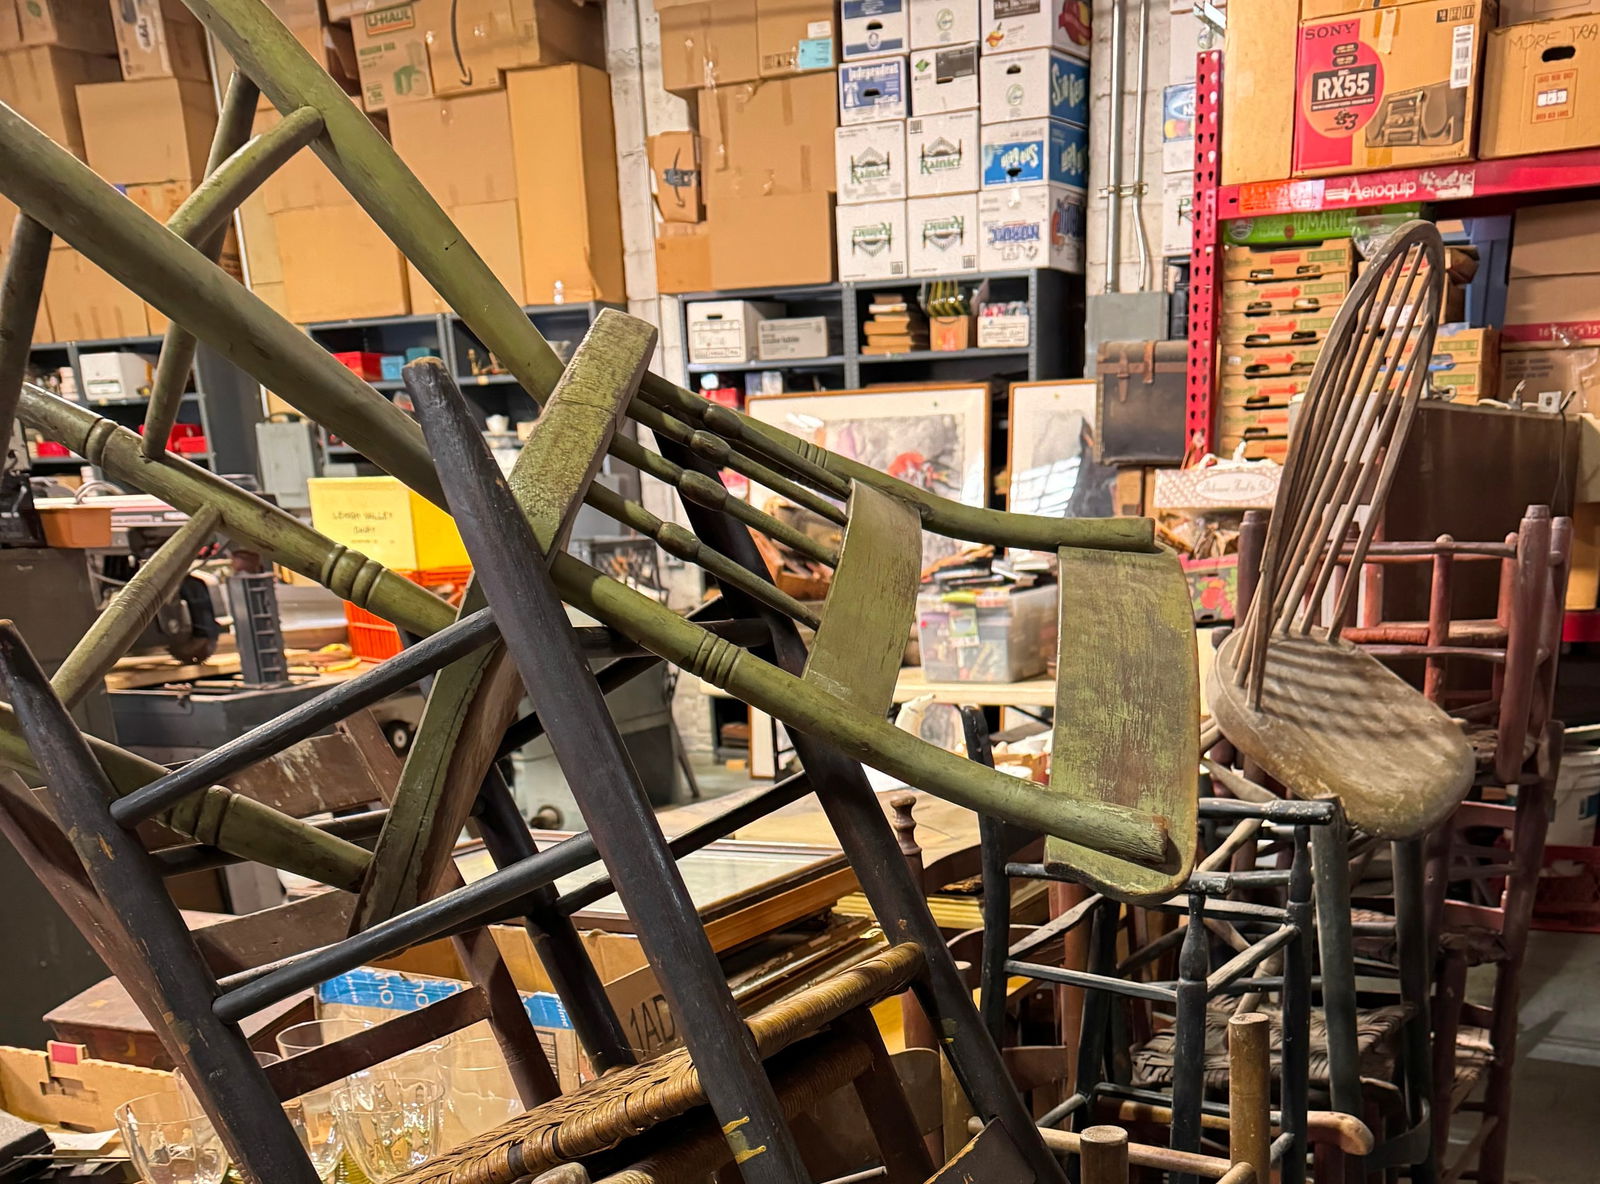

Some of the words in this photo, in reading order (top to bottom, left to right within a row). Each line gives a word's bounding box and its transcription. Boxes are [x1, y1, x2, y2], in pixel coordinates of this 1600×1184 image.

[367, 10, 411, 27] U-HAUL
[1305, 23, 1356, 41] SONY
[1509, 31, 1560, 53] MORE
[1316, 72, 1370, 100] RX55
[1346, 178, 1416, 202] Aeroquip
